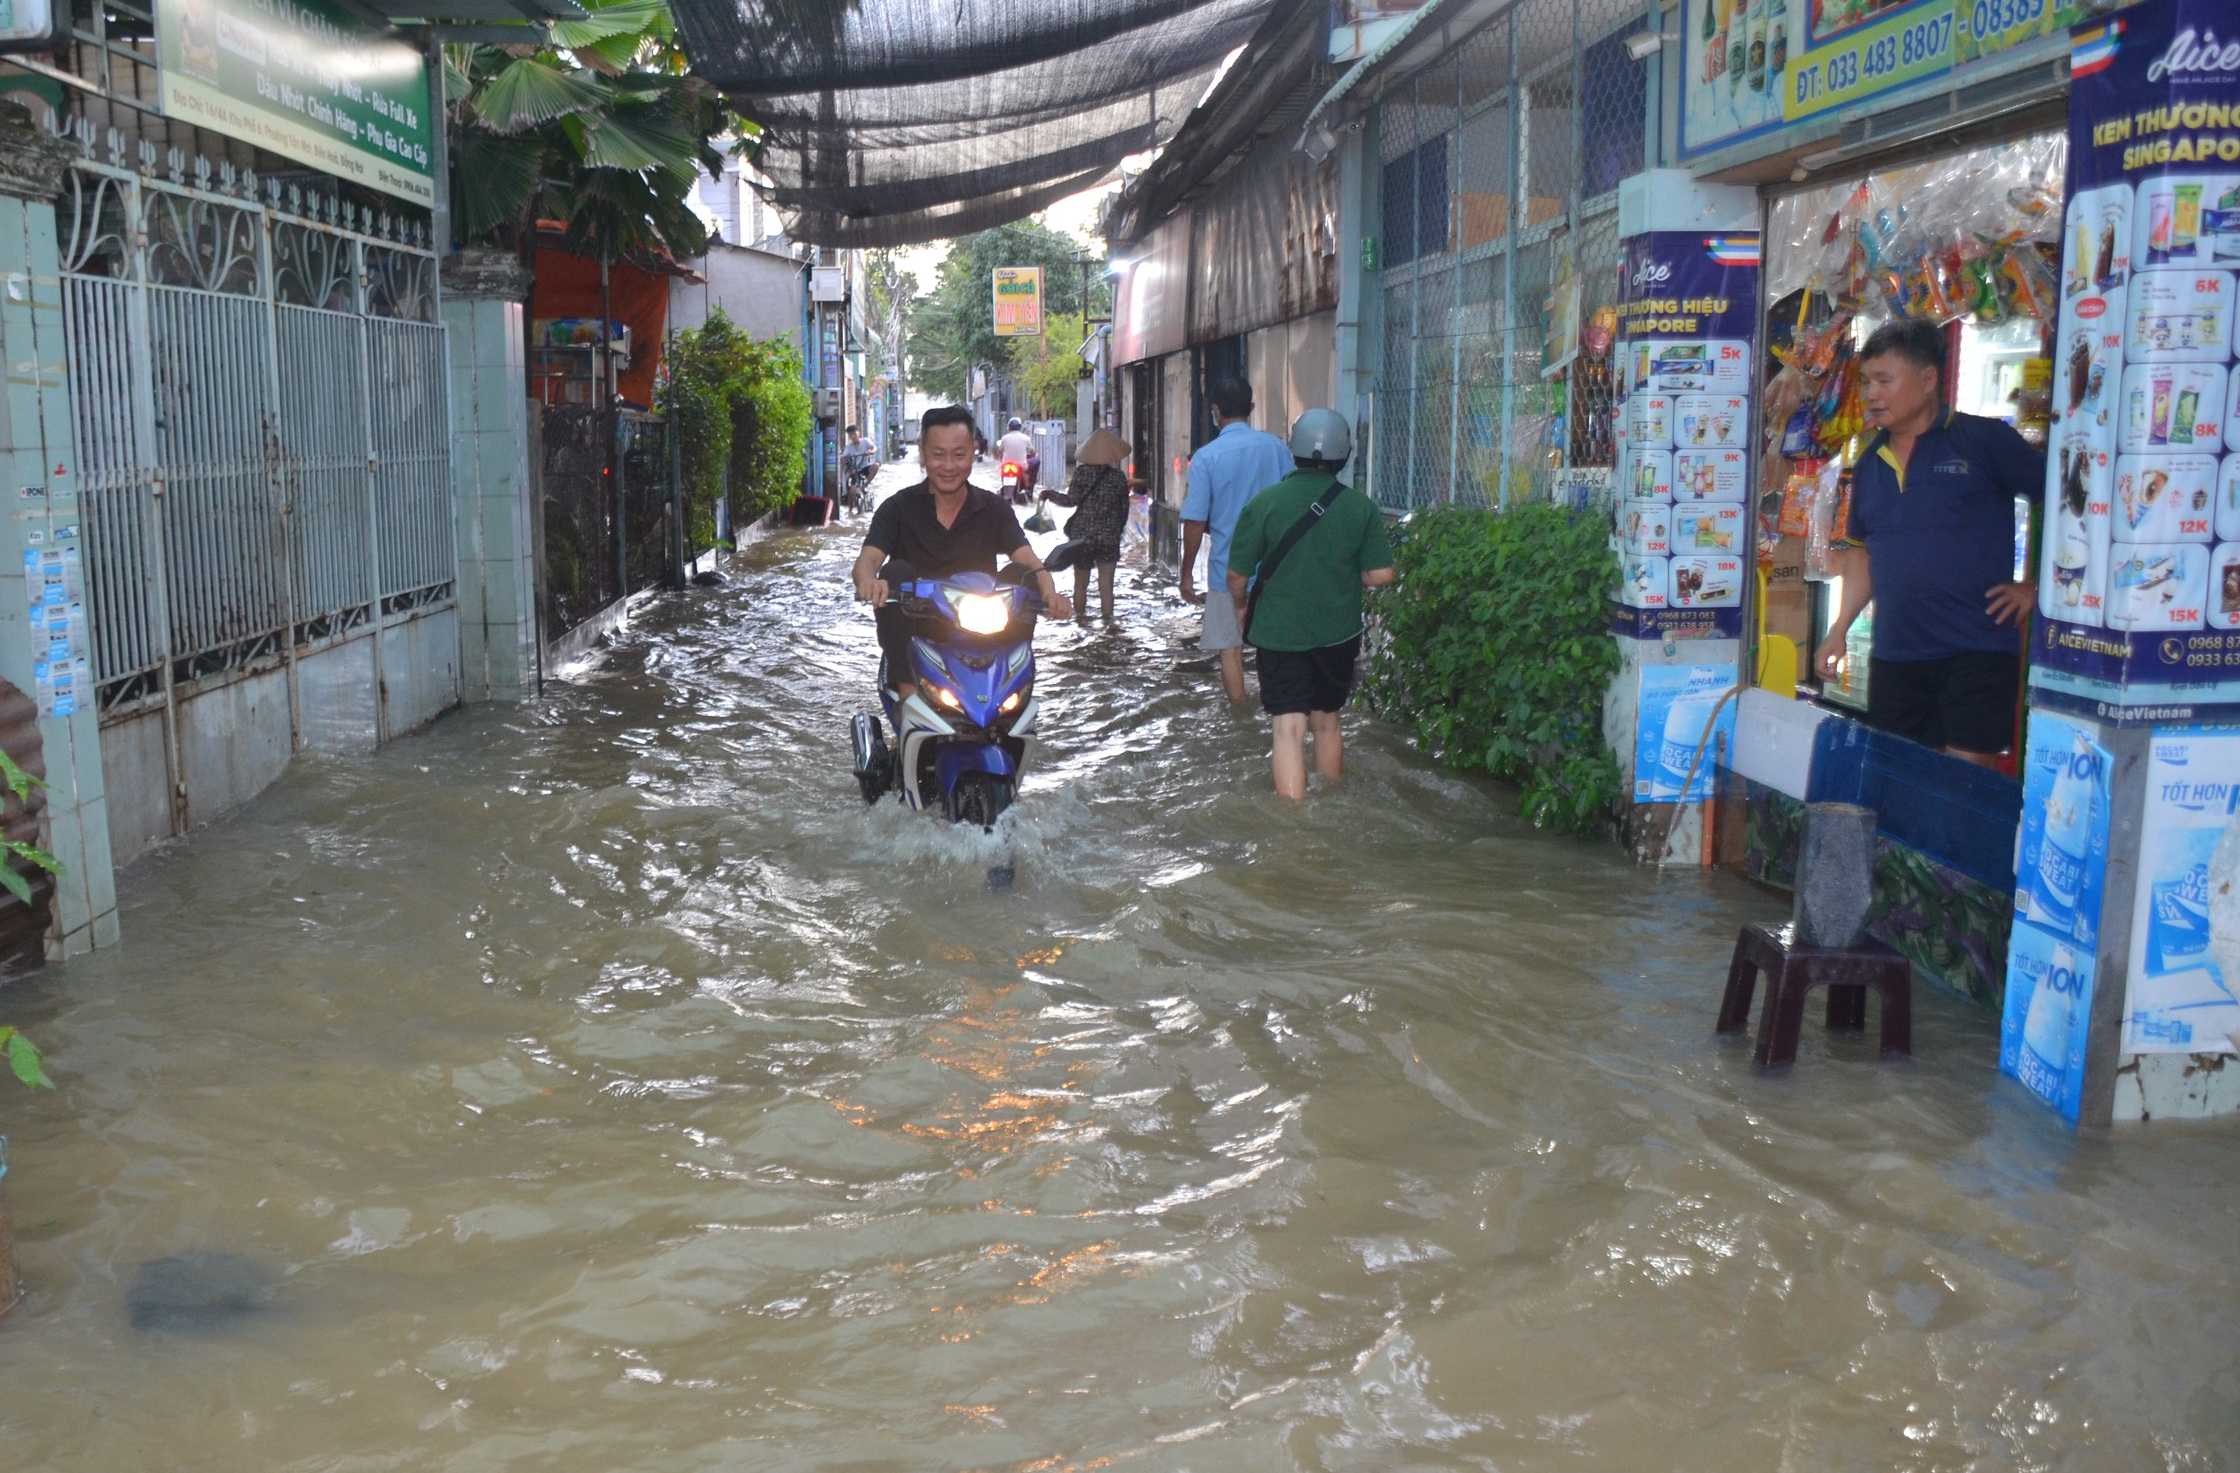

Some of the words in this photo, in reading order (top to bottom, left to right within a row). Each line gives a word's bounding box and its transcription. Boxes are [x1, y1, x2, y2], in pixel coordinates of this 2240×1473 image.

[1796, 66, 1822, 105] ĐT:
[1827, 51, 1857, 93] 033
[1863, 35, 1896, 80] 483
[1902, 13, 1952, 66] 8807
[2147, 29, 2240, 82] Aice
[389, 100, 404, 124] Full
[406, 107, 418, 130] Xe
[308, 96, 334, 125] Chính
[367, 122, 383, 150] Phụ
[385, 129, 398, 152] Gia
[398, 136, 412, 159] Cao
[2094, 117, 2131, 147] KEM
[2195, 279, 2220, 293] 6K
[1682, 296, 1728, 317] HIỆU
[2103, 335, 2120, 348] 10K
[2194, 424, 2218, 437] 8K
[1654, 485, 1669, 493] 8K
[2088, 503, 2109, 515] 10K
[2179, 521, 2208, 533] 12K
[1647, 543, 1666, 551] 12K
[1718, 563, 1736, 571] 18K
[1644, 596, 1664, 604] 15K
[2081, 595, 2102, 609] 25K
[1657, 612, 1679, 620] 0968
[2169, 610, 2199, 623] 15K
[2058, 633, 2133, 658] AICEVIETNAM
[2188, 637, 2222, 650] 0968
[2187, 654, 2221, 666] 0933
[2108, 704, 2193, 720] AiceVietnam
[2067, 752, 2104, 783] ION
[2161, 780, 2190, 801] TỐT
[2192, 783, 2228, 801] HƠN
[2046, 963, 2085, 1001] ION
